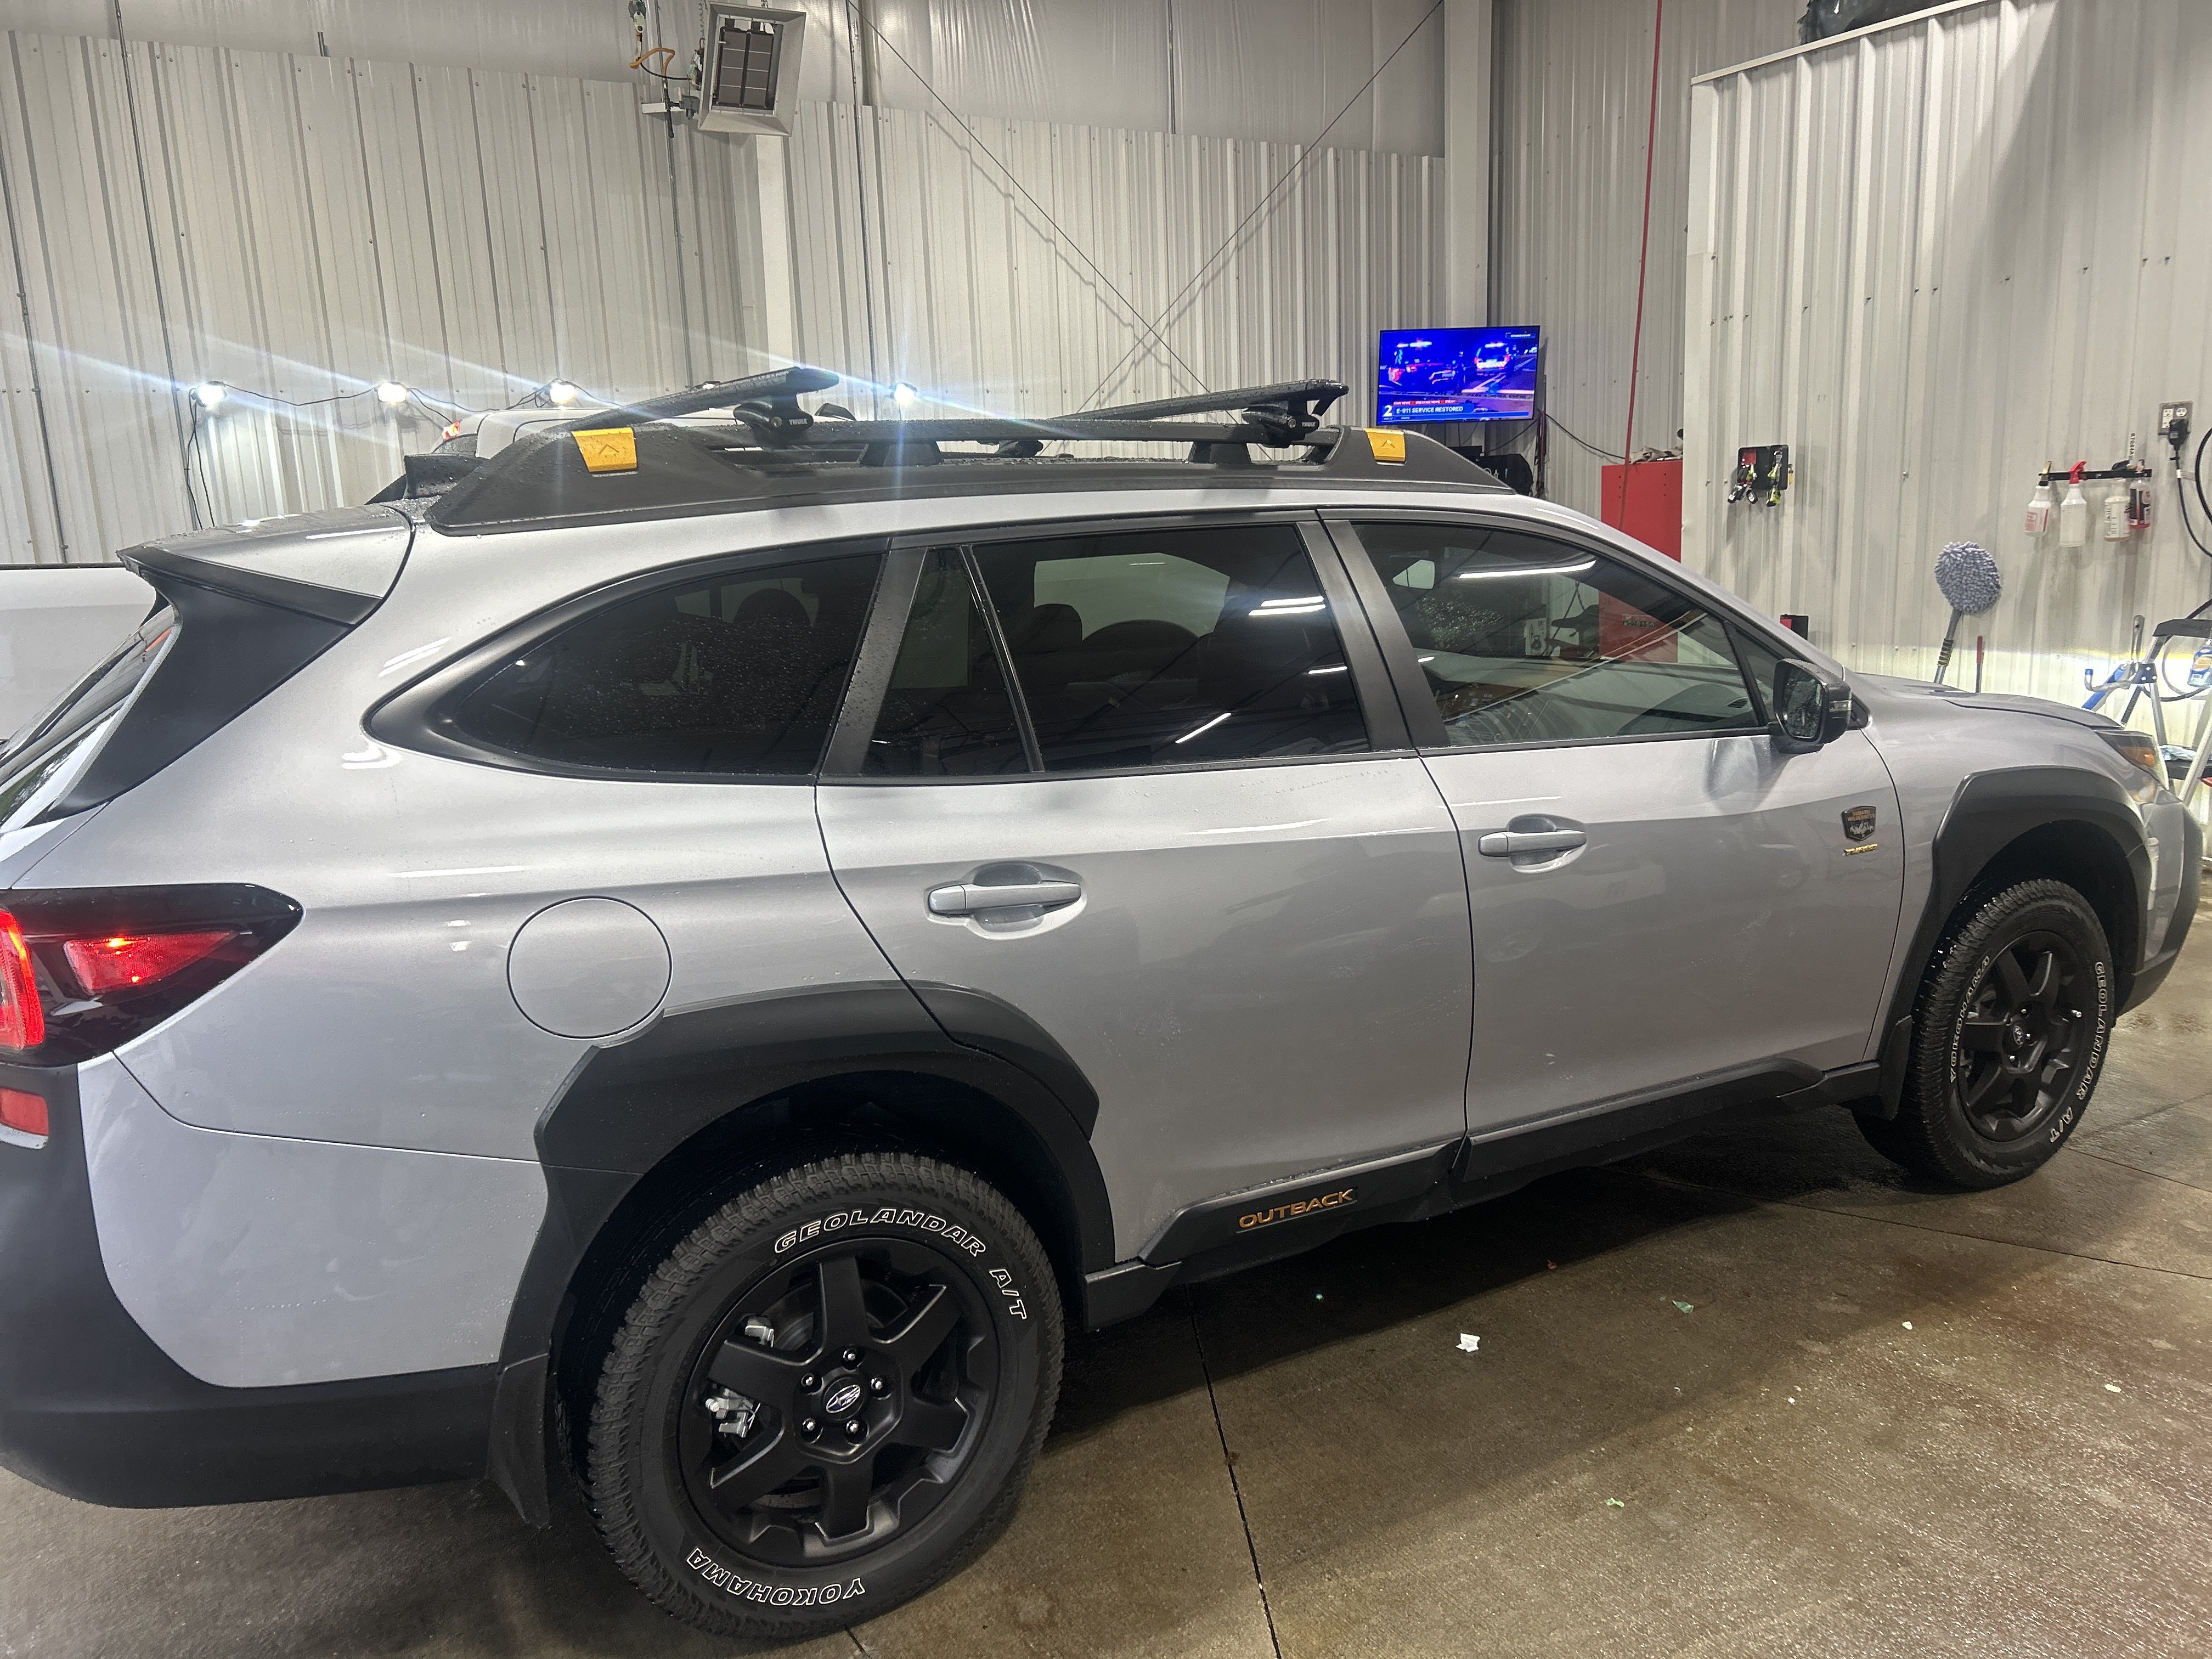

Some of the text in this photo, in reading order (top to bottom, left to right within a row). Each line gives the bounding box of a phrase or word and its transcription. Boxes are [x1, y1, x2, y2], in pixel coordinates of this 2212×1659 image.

[1383, 405, 1392, 416] 2
[2050, 962, 2107, 1143] GEOLANDAR A/T
[1239, 1188, 1353, 1228] OUTBACK
[775, 1209, 1027, 1320] GEOLANDAR A/T
[687, 1548, 865, 1605] YOKOHAMA
